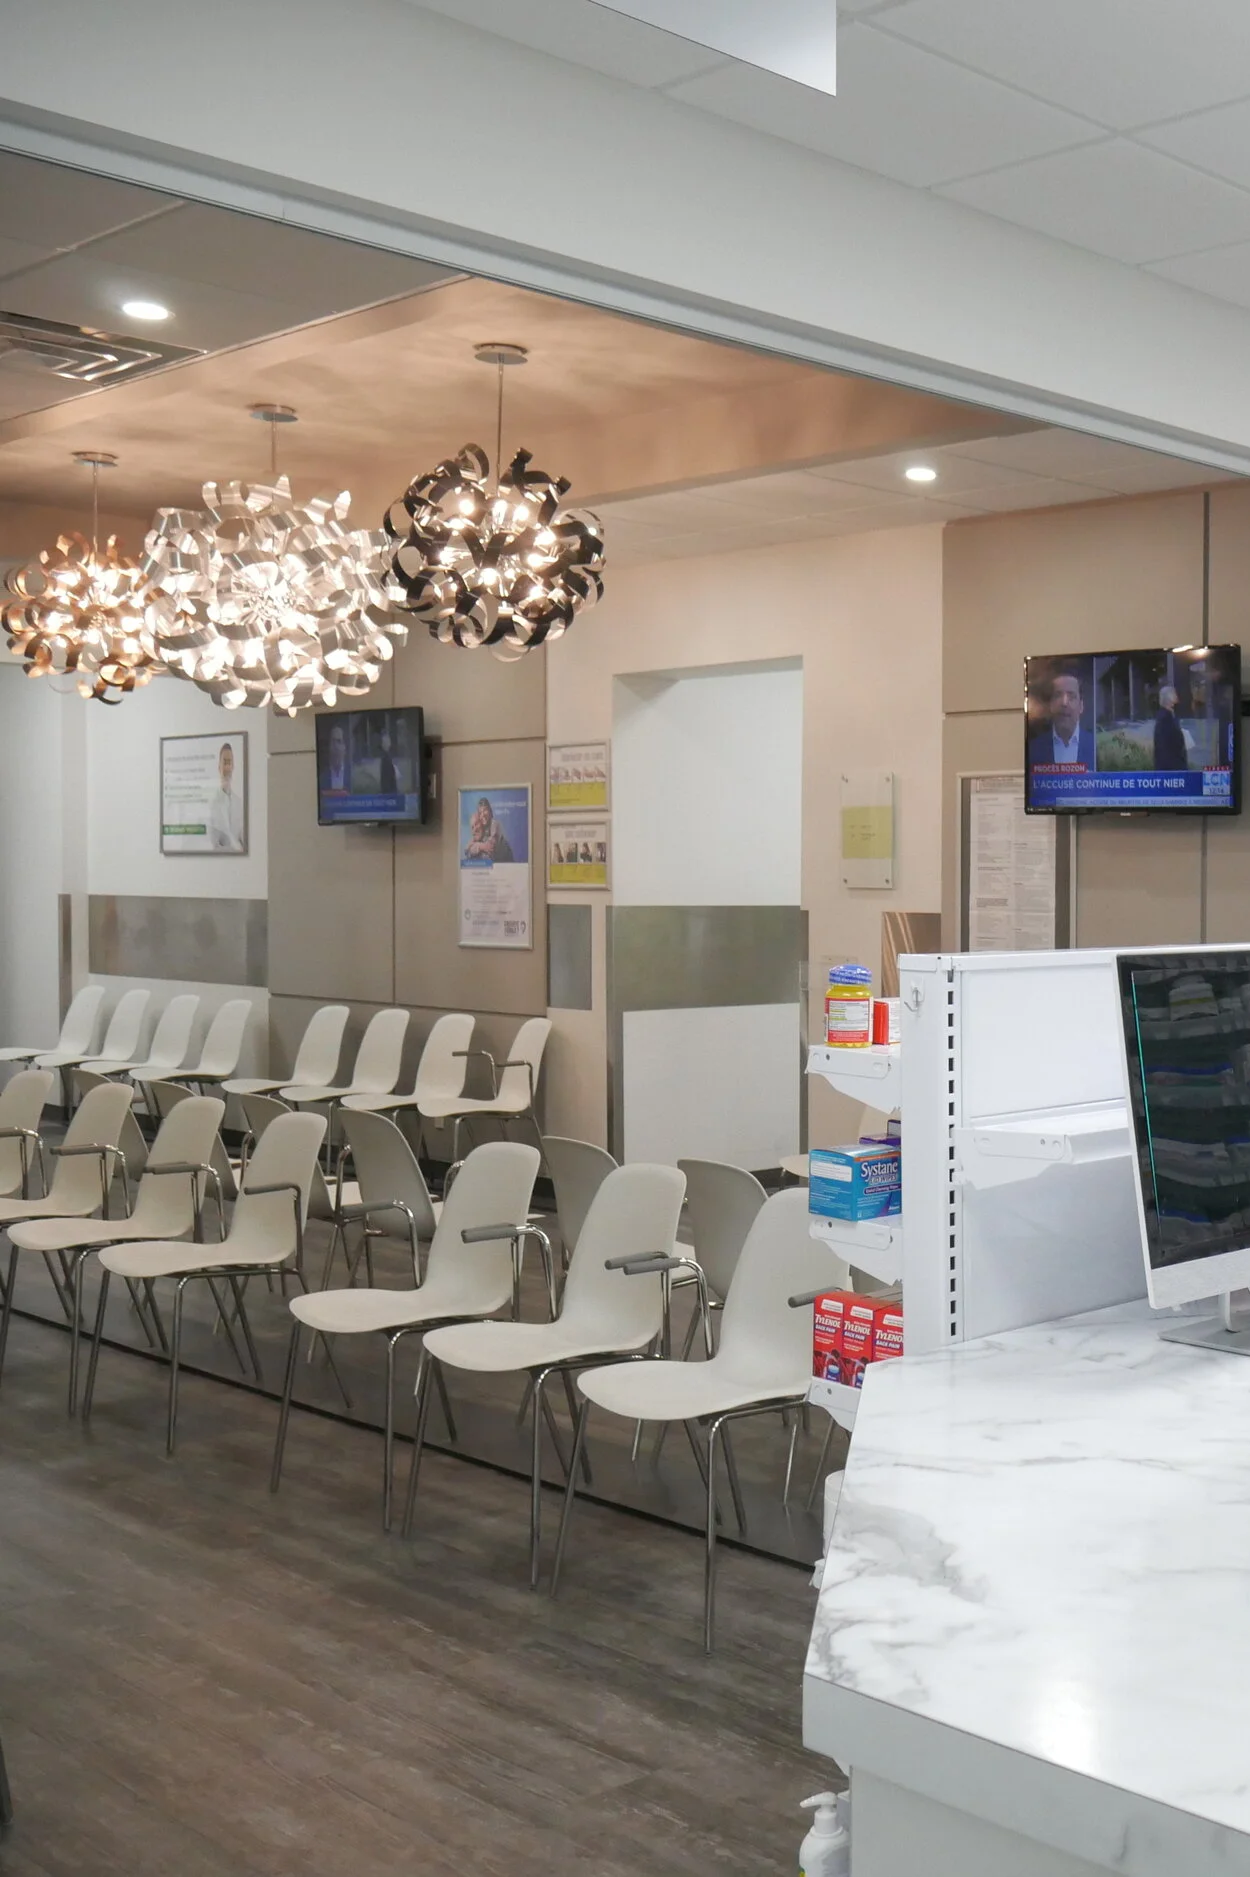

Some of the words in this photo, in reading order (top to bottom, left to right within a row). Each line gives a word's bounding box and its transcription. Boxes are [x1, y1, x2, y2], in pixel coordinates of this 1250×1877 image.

[1061, 764, 1085, 773] ROZON
[1033, 777, 1074, 789] L'ACCUSÉ
[1076, 779, 1121, 789] CONTINUE
[1122, 779, 1135, 789] DE
[1137, 778, 1161, 788] TOUT
[1163, 777, 1185, 788] NIER
[1203, 772, 1230, 787] LCN
[861, 1161, 898, 1182] Systane
[815, 1314, 841, 1328] TYLENOL
[844, 1320, 870, 1335] TYLENOL
[827, 1326, 836, 1334] PAIN
[844, 1331, 855, 1339] BACK
[855, 1333, 865, 1341] PAIN
[875, 1329, 903, 1343] TYLENO
[876, 1339, 889, 1347] BACK
